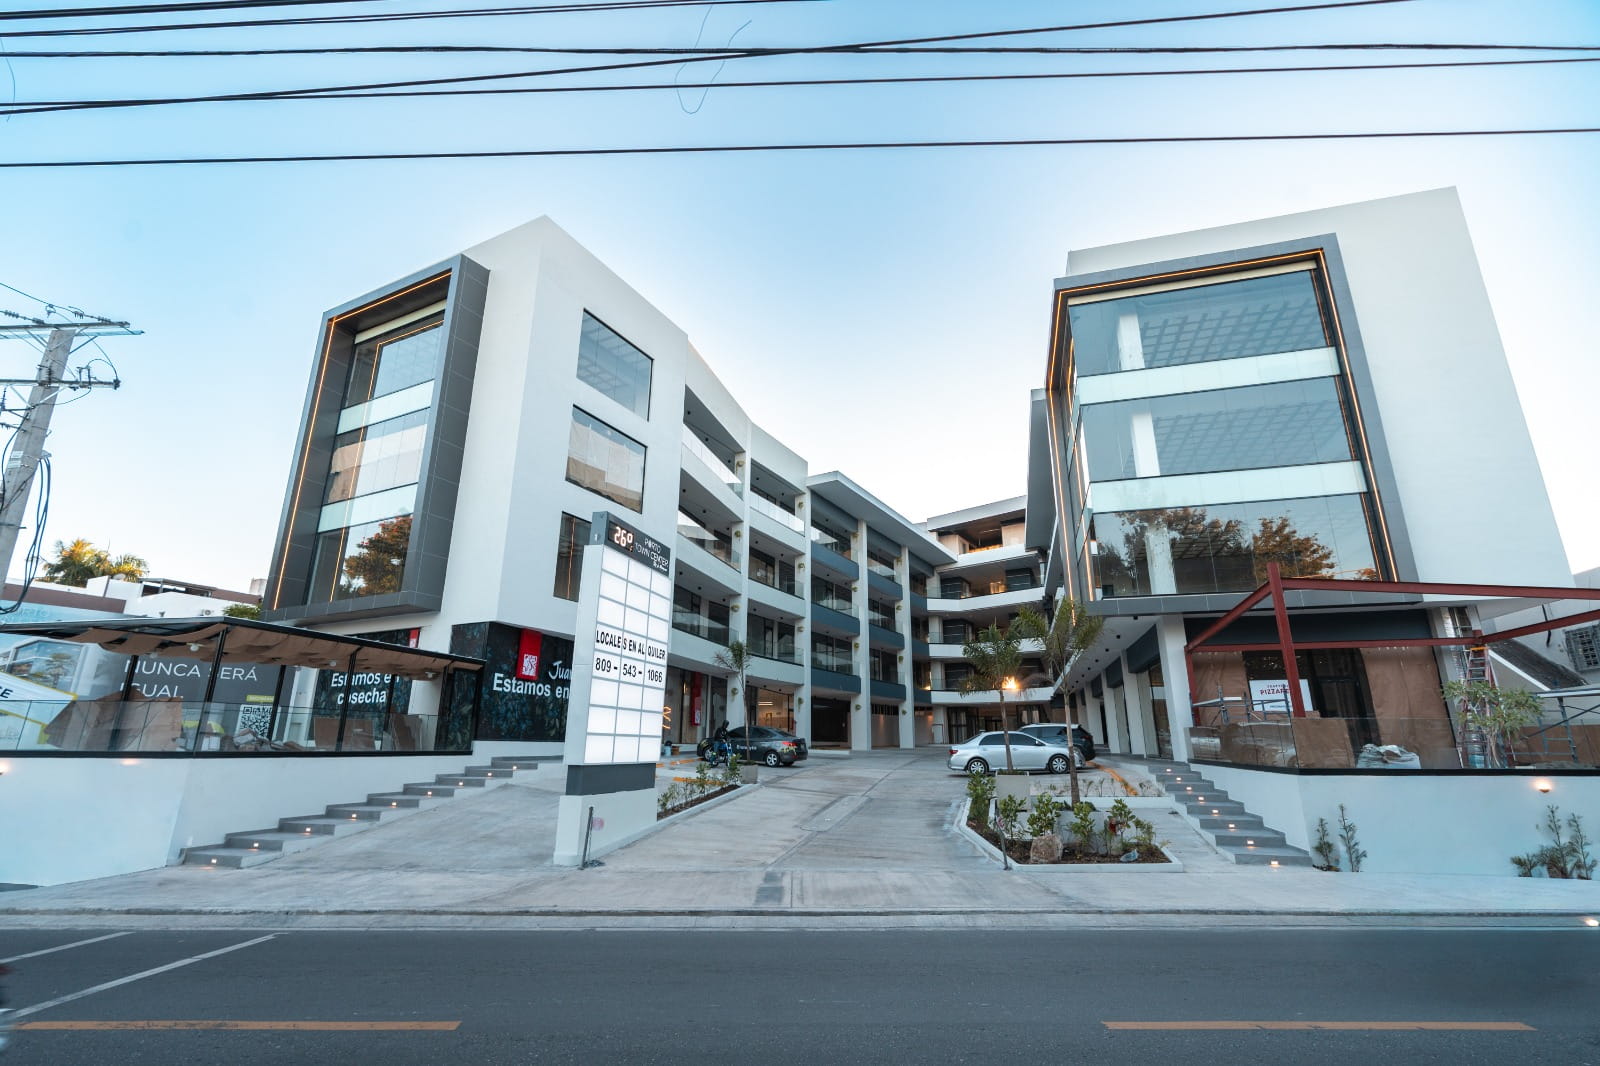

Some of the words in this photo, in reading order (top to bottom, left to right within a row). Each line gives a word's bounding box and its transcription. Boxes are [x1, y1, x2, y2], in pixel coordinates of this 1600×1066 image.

[628, 640, 637, 652] EN
[207, 665, 258, 681] ERÁ
[384, 673, 400, 684] e
[647, 669, 663, 683] 1066
[492, 672, 551, 697] Estamos
[337, 687, 387, 705] csecha
